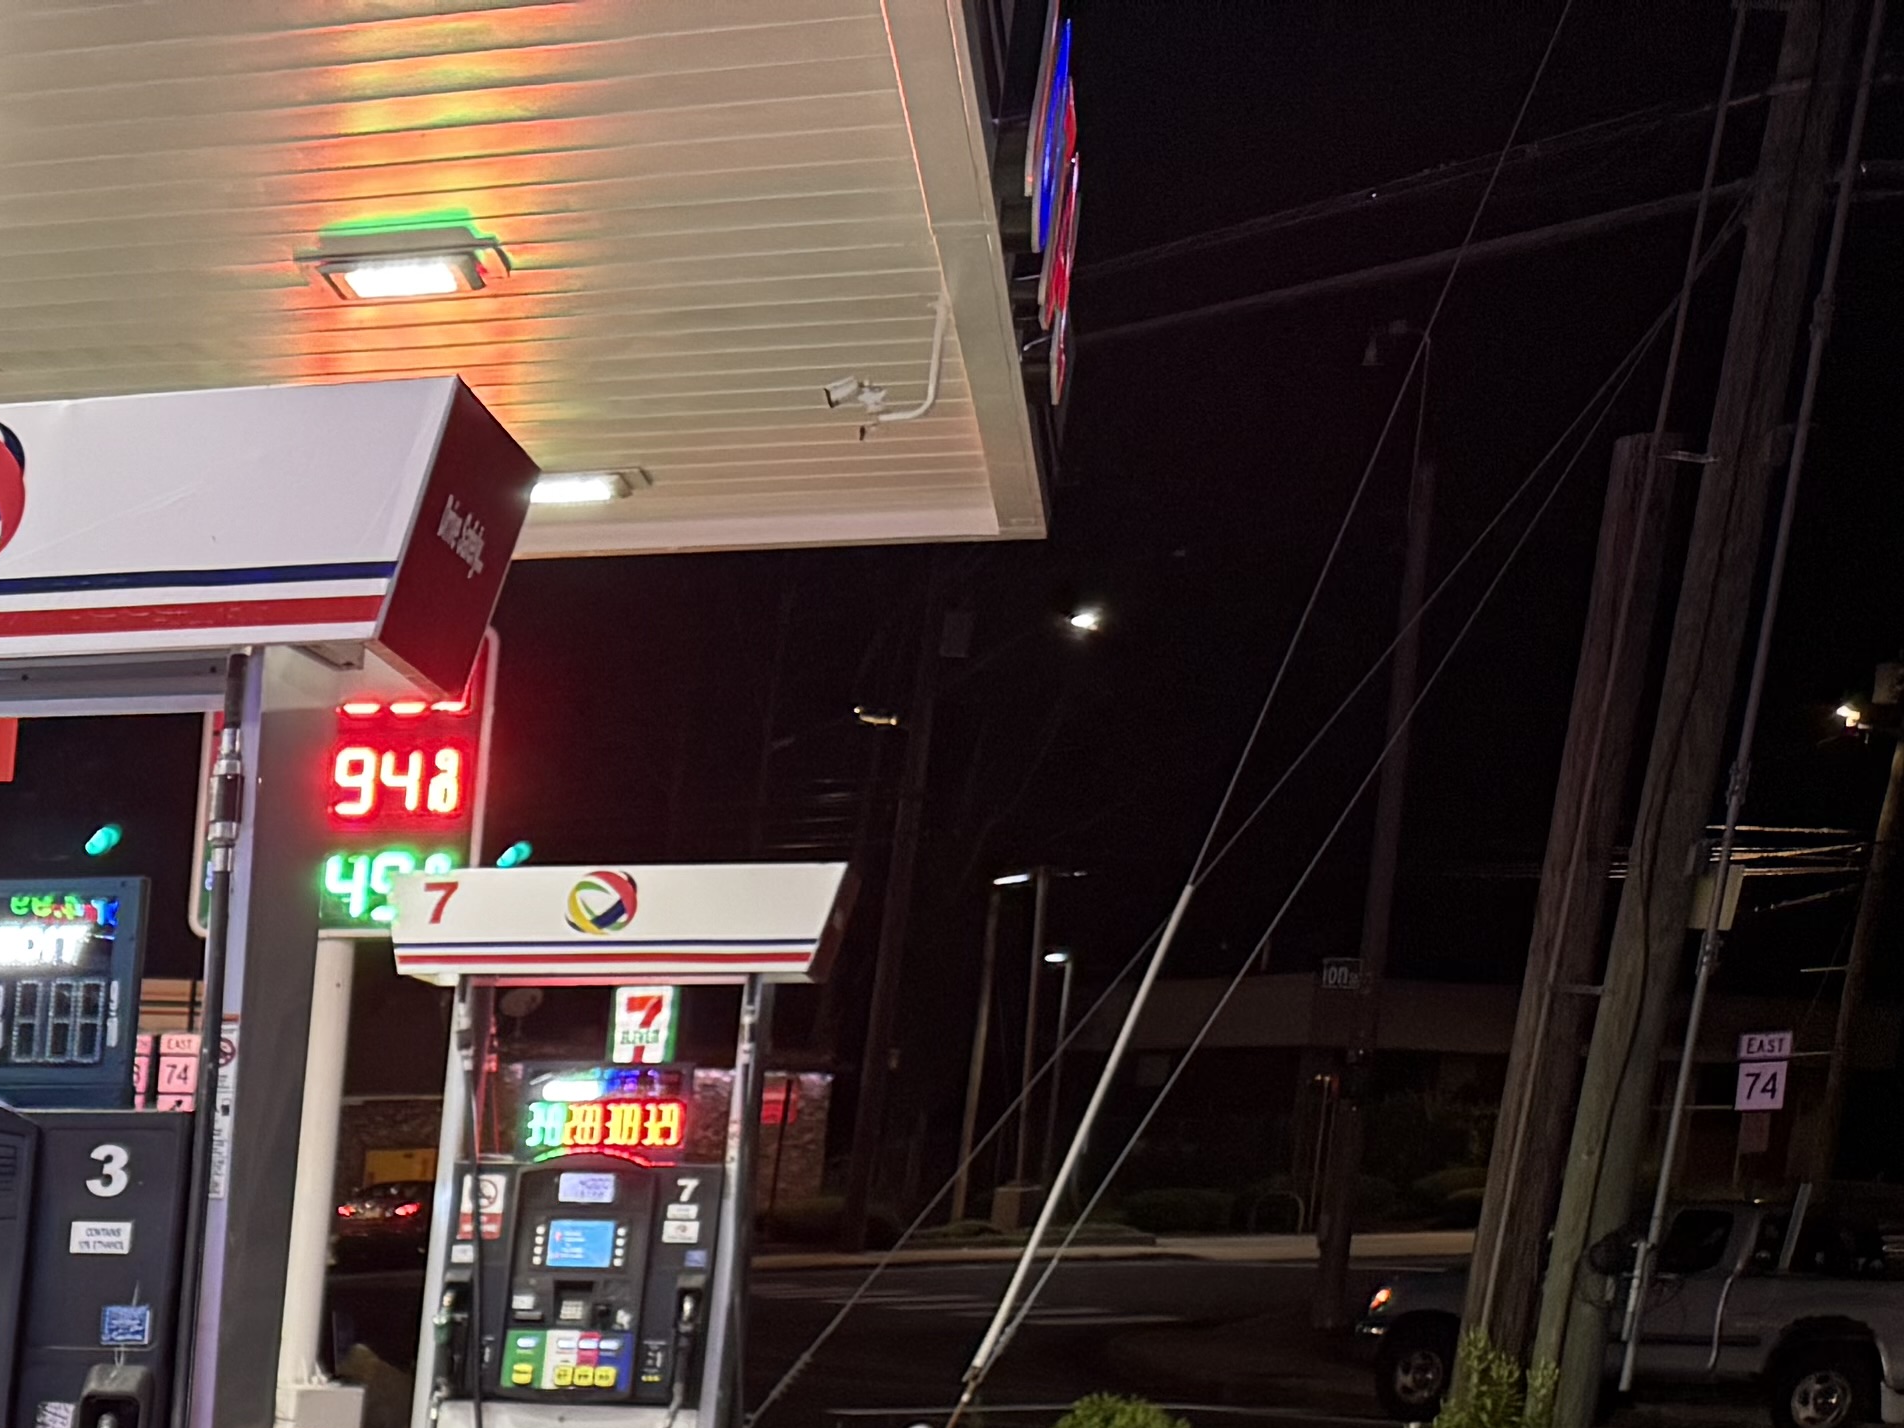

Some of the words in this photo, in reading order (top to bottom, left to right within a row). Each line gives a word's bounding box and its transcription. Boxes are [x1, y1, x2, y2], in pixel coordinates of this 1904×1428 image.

[424, 881, 460, 925] 7
[166, 1038, 193, 1050] EAST
[1746, 1036, 1786, 1054] EAST
[166, 1063, 189, 1085] 74
[1744, 1072, 1778, 1100] 74
[85, 1144, 129, 1197] 3
[677, 1179, 699, 1202] 7
